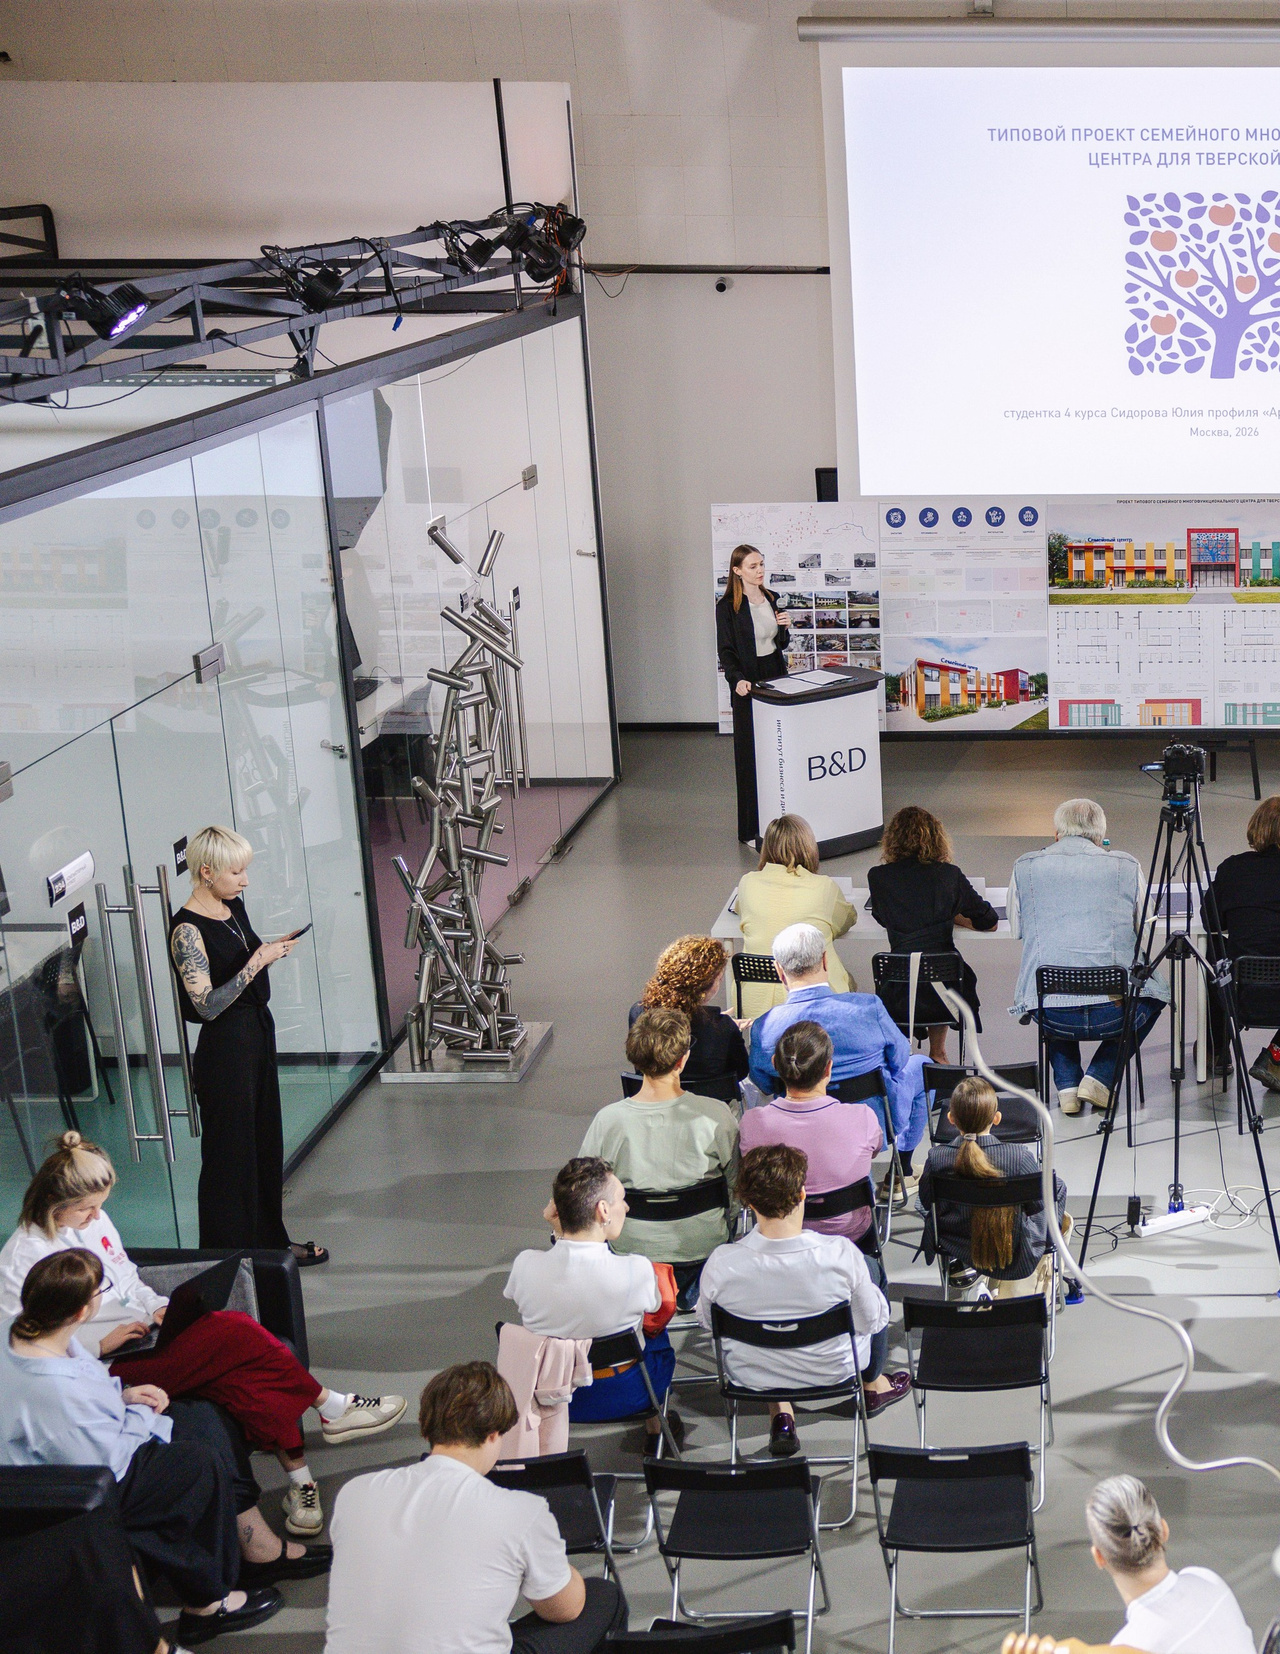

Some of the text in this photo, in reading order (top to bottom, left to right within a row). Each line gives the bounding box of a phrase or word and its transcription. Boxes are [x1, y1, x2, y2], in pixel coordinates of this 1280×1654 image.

[987, 125, 1066, 142] ТИПОВОЙ
[1071, 128, 1136, 142] ПРОЕКТ
[1140, 125, 1241, 142] СЕМЕЙНОГО
[1088, 152, 1153, 168] ЦЕНТРА
[1156, 152, 1191, 168] ДЛЯ
[1196, 149, 1280, 166] ТВЕРСКОЙ
[1003, 408, 1061, 420] студентка
[1064, 408, 1071, 418] 4
[1074, 409, 1107, 420] курса
[1110, 407, 1168, 420] Сидорова
[1171, 407, 1204, 418] Юлия
[1207, 407, 1259, 420] профиля
[1189, 427, 1260, 438] Москва, 2026
[776, 720, 784, 757] институт
[808, 747, 866, 781] B&D
[71, 915, 85, 934] B&D
